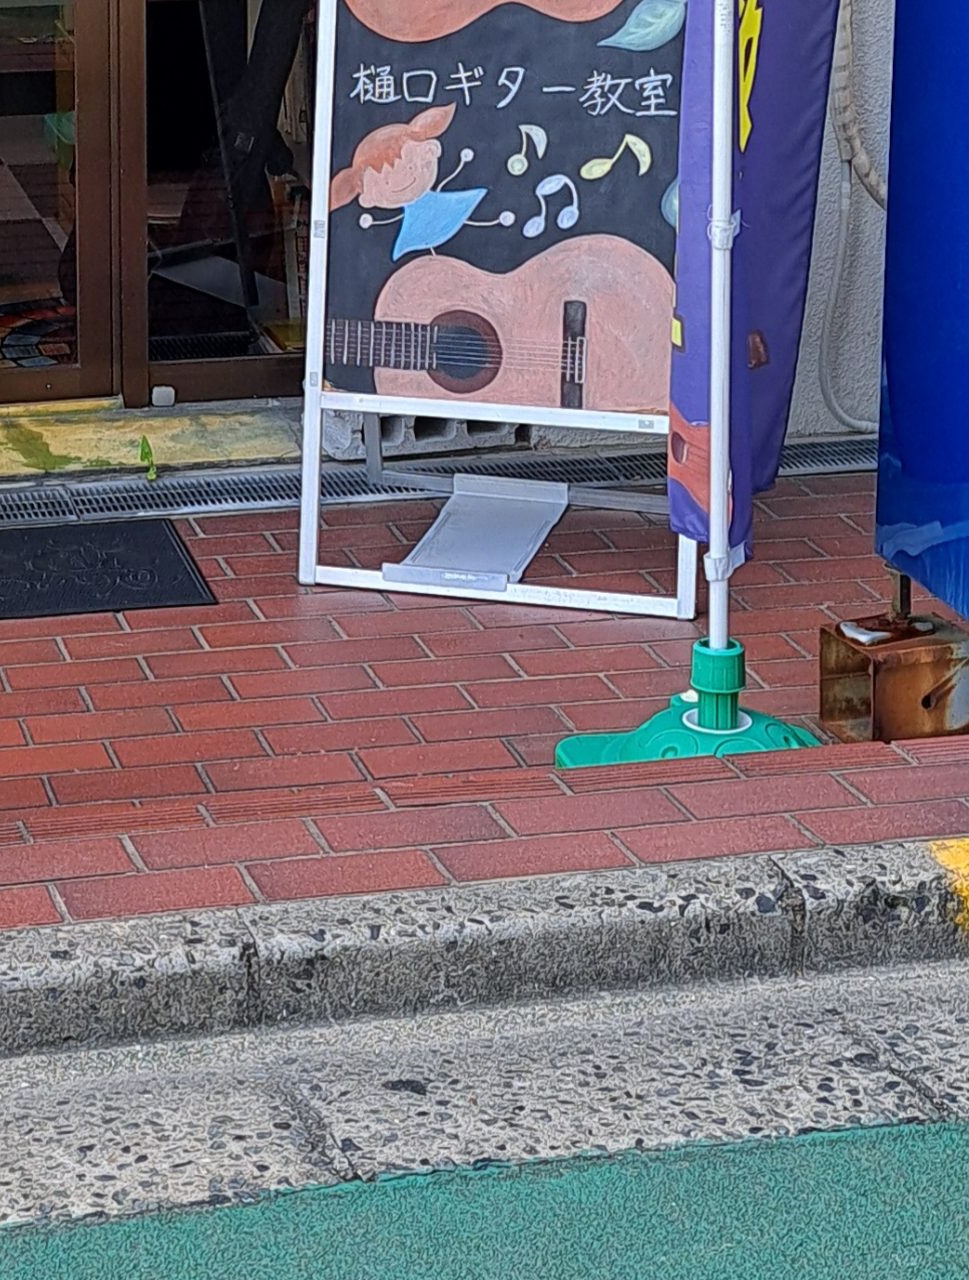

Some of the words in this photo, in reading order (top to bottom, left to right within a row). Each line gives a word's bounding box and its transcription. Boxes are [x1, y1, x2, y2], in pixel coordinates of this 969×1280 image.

[349, 62, 679, 118] 樋口ギター教室
